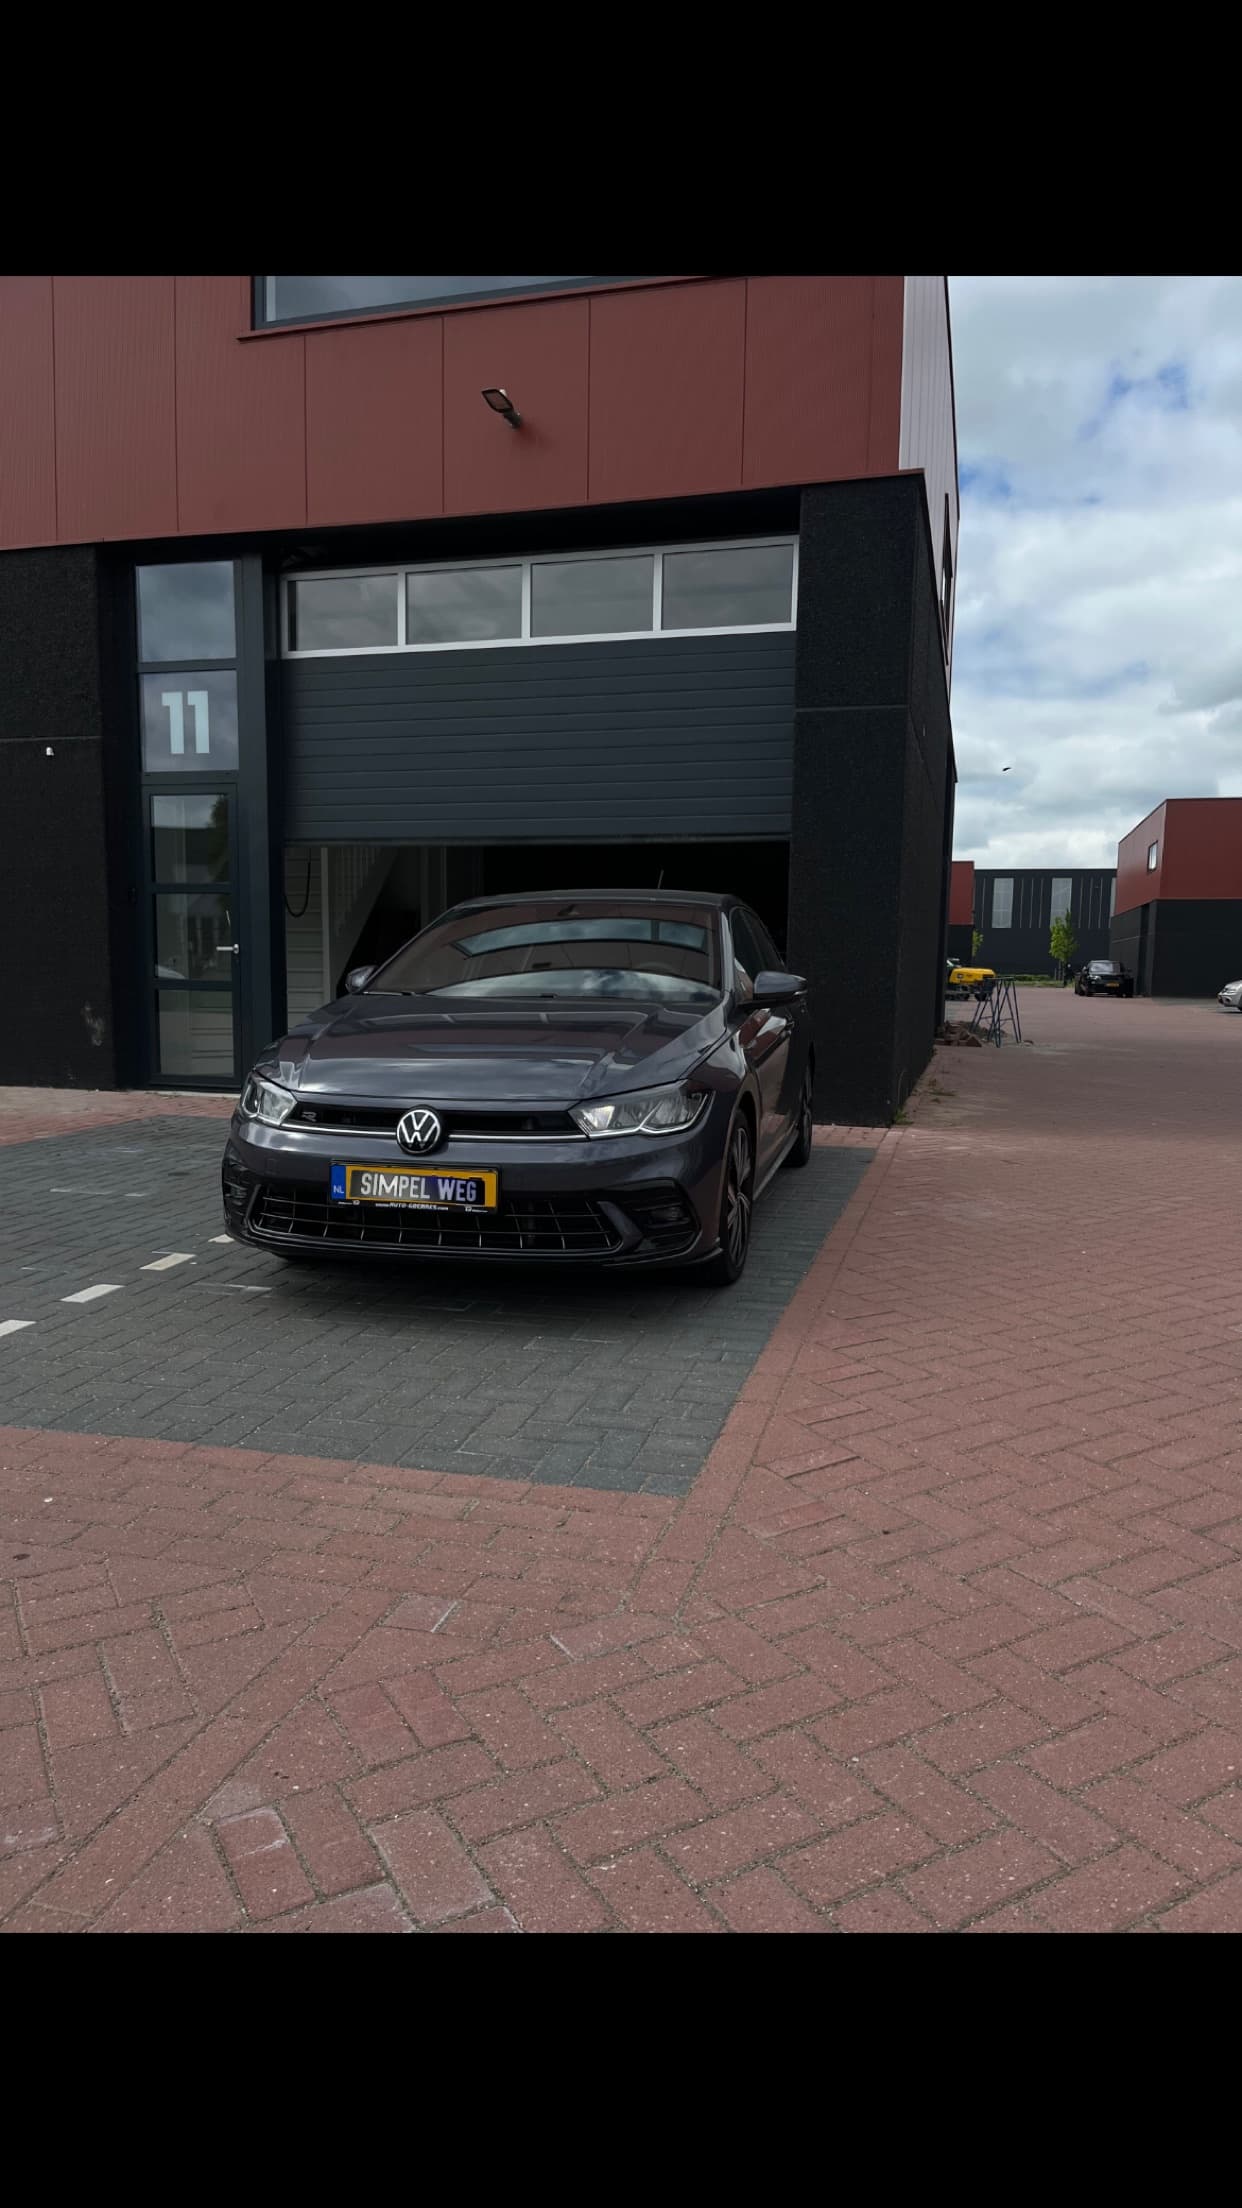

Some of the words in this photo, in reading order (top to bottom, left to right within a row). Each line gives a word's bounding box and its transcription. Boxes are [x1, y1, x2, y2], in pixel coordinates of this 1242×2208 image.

[161, 690, 210, 755] 11
[333, 1185, 345, 1194] NL
[360, 1172, 431, 1199] SIMPEL
[437, 1178, 477, 1202] WEG
